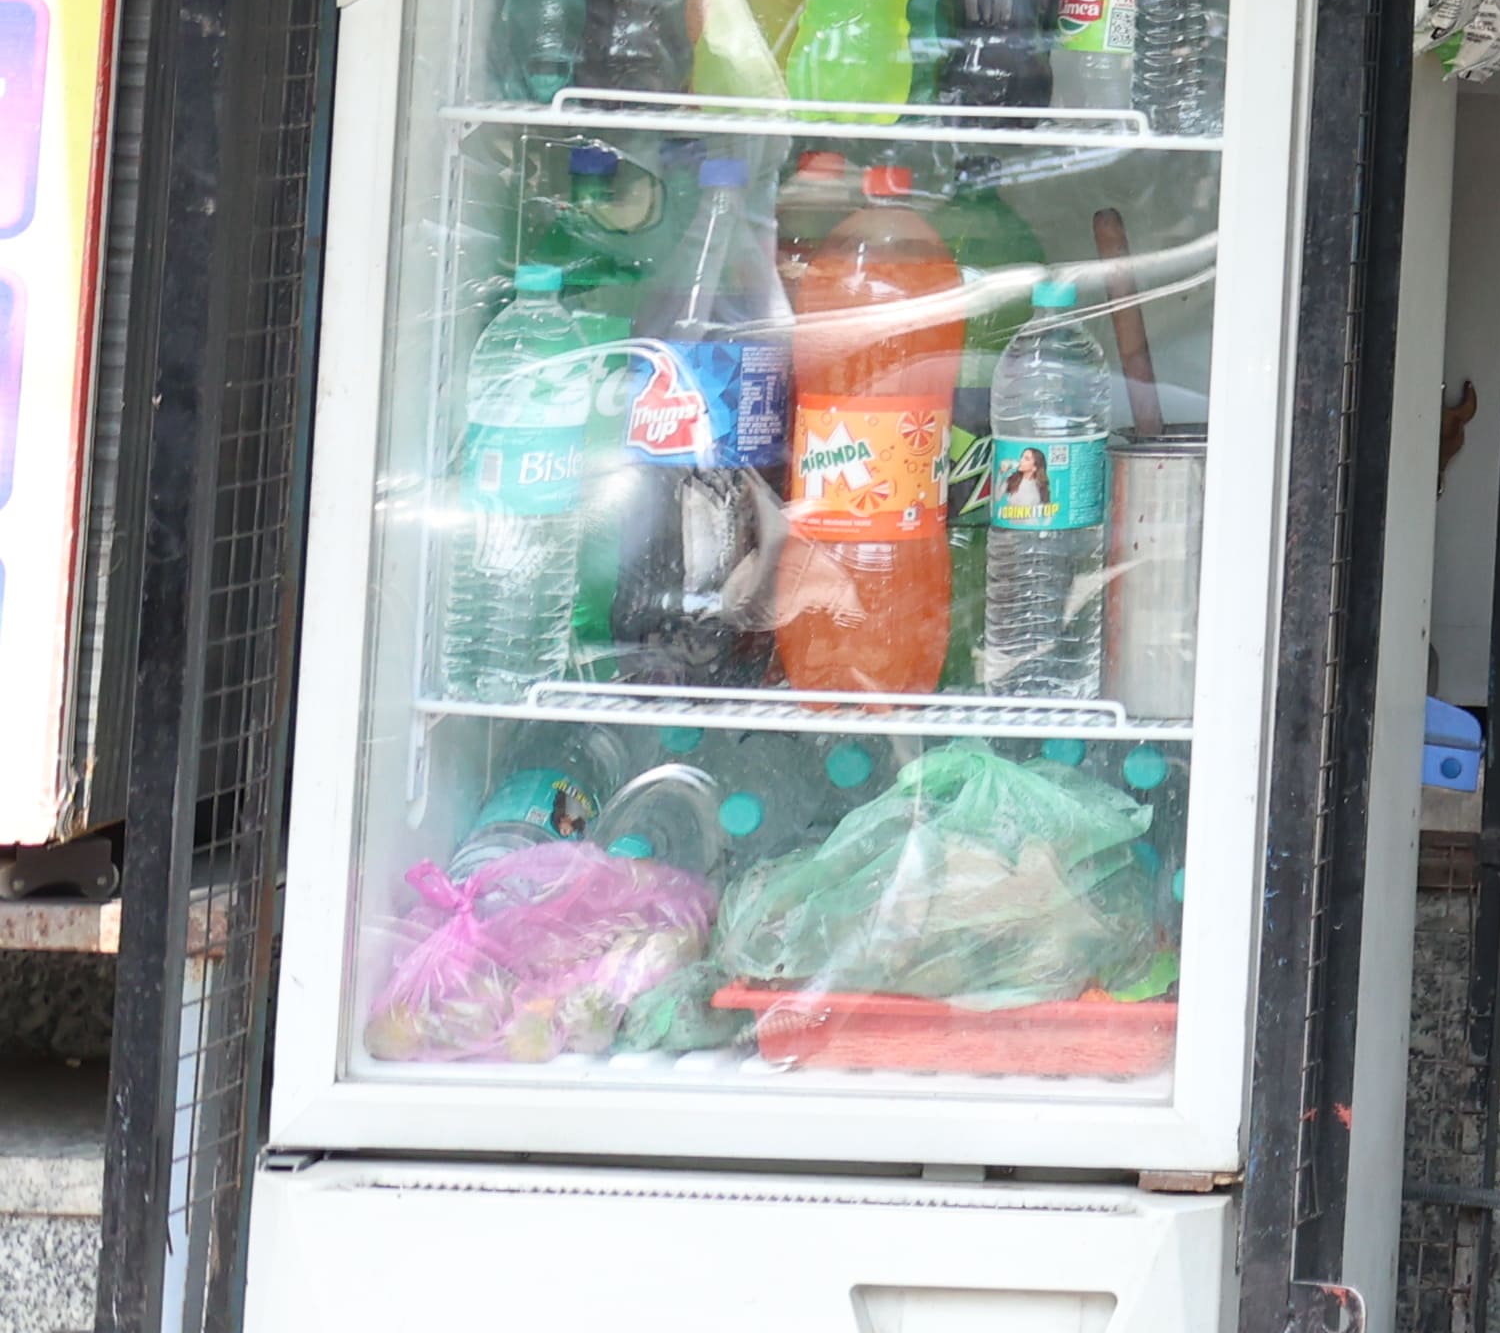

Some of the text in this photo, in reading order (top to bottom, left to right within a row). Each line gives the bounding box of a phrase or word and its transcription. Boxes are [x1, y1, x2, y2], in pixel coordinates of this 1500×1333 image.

[1058, 0, 1101, 18] Limca
[633, 403, 698, 430] Thums
[646, 418, 679, 442] UP
[518, 445, 584, 486] Bisle
